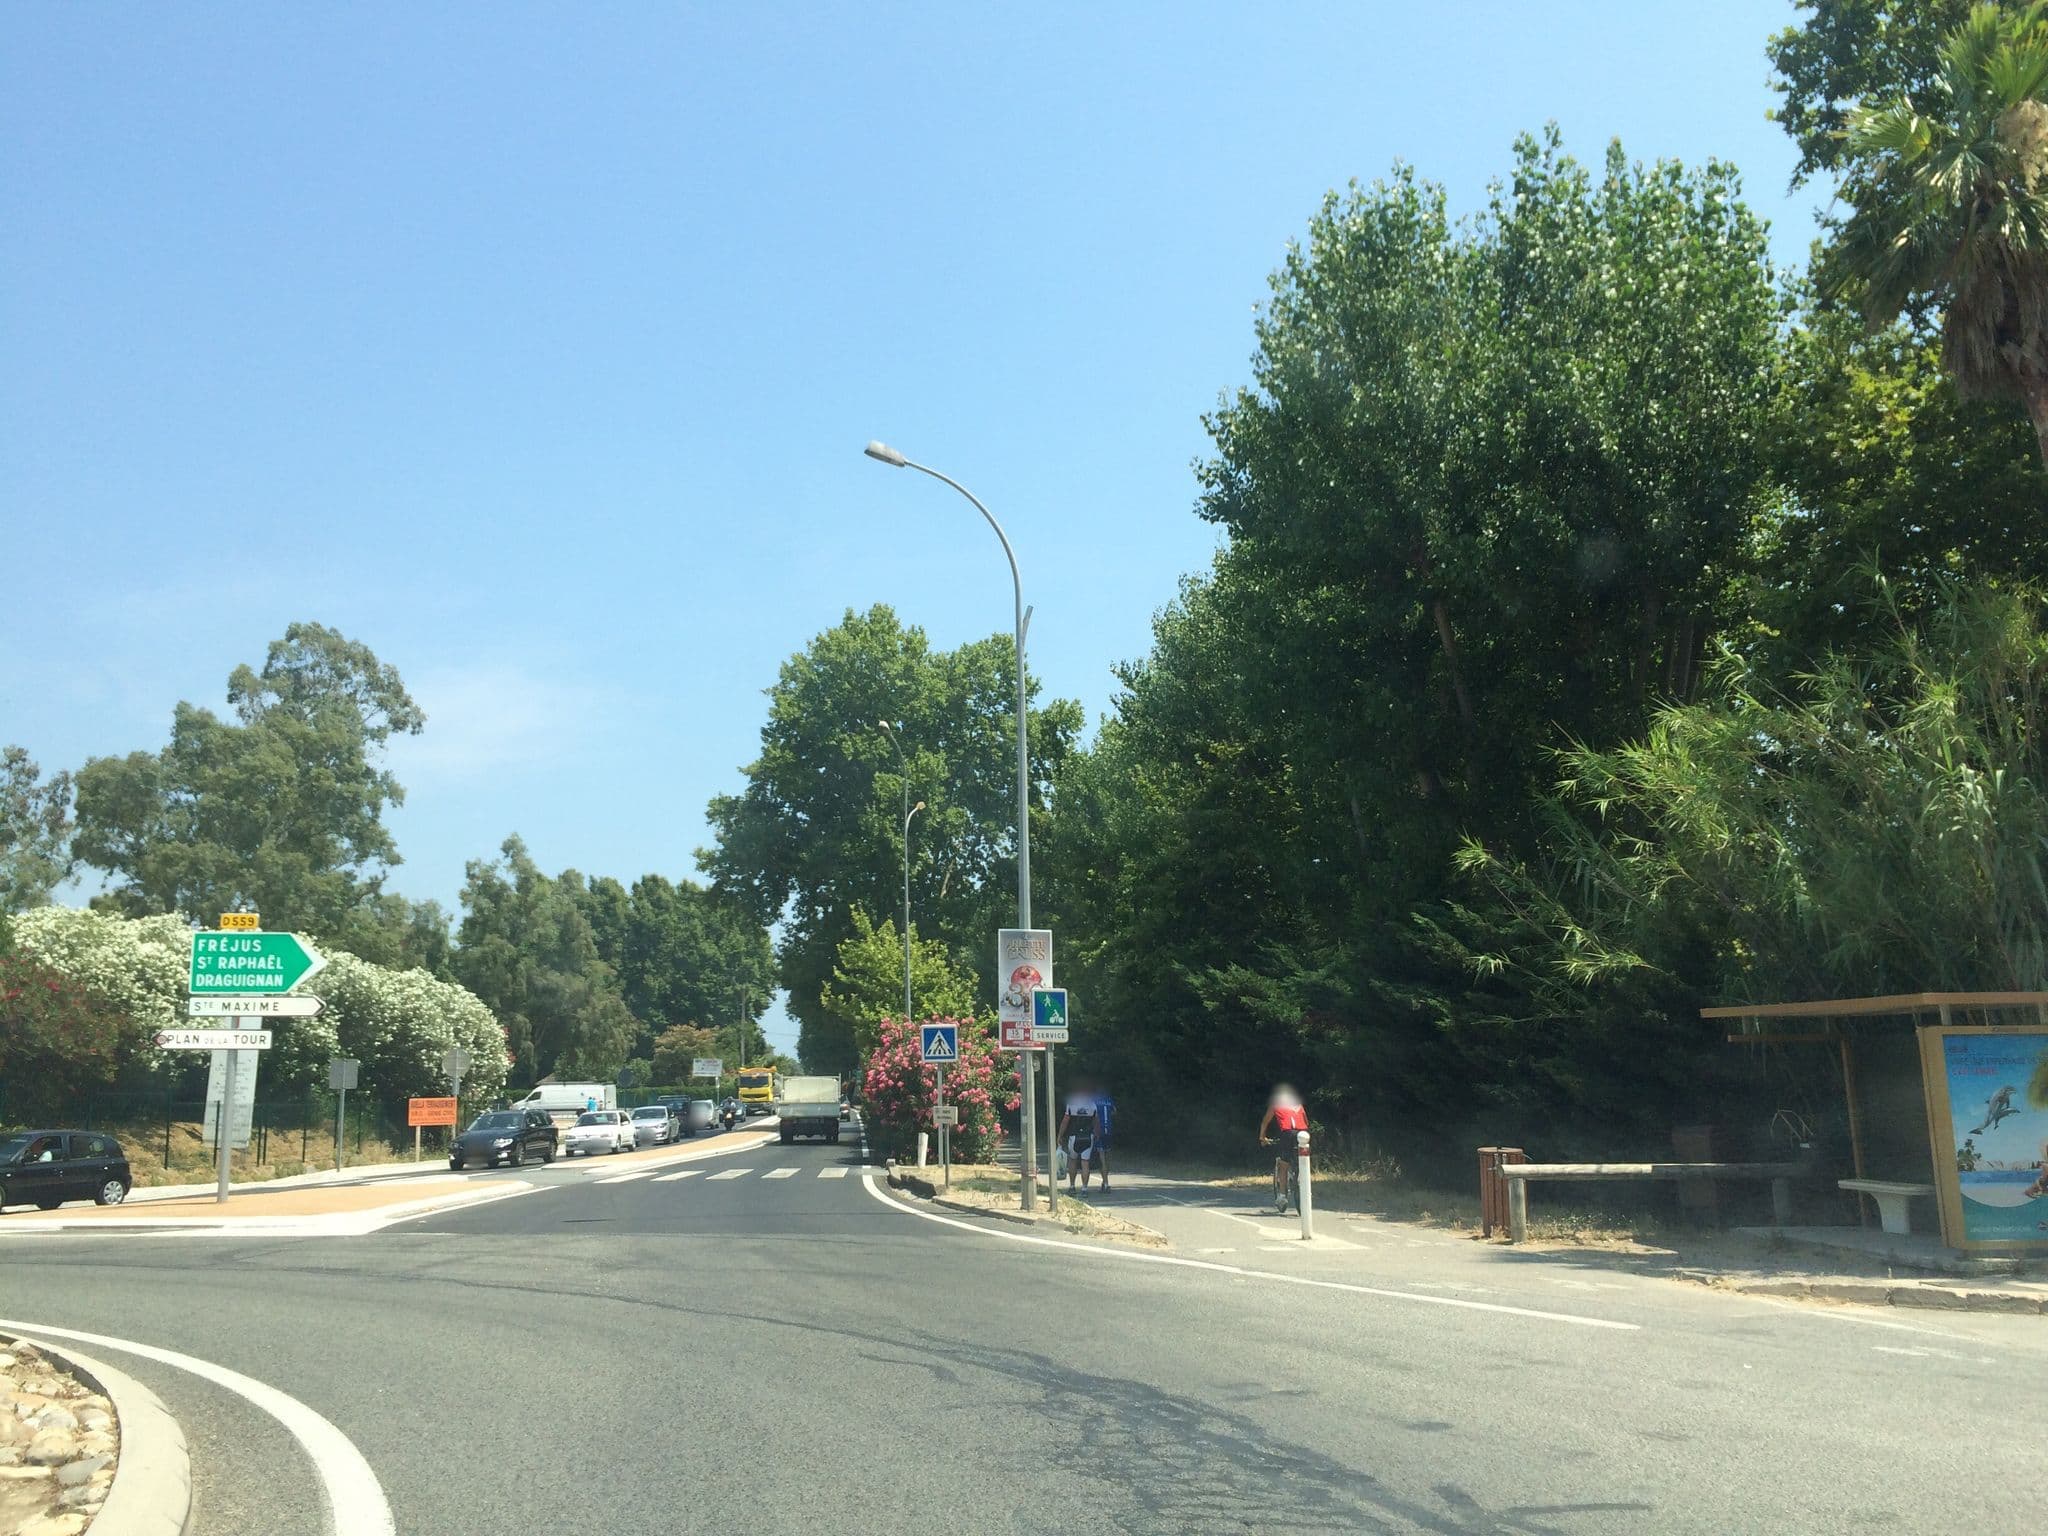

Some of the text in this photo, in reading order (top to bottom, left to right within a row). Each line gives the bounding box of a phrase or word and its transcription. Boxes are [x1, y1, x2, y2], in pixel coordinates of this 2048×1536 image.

[198, 937, 262, 952] FRÉJUS
[218, 955, 284, 970] RAPHAËL
[195, 974, 283, 987] DRAGUIGNAN
[221, 1001, 279, 1012] MAXIME
[167, 1034, 200, 1044] PLAN
[233, 1034, 267, 1045] TOUR
